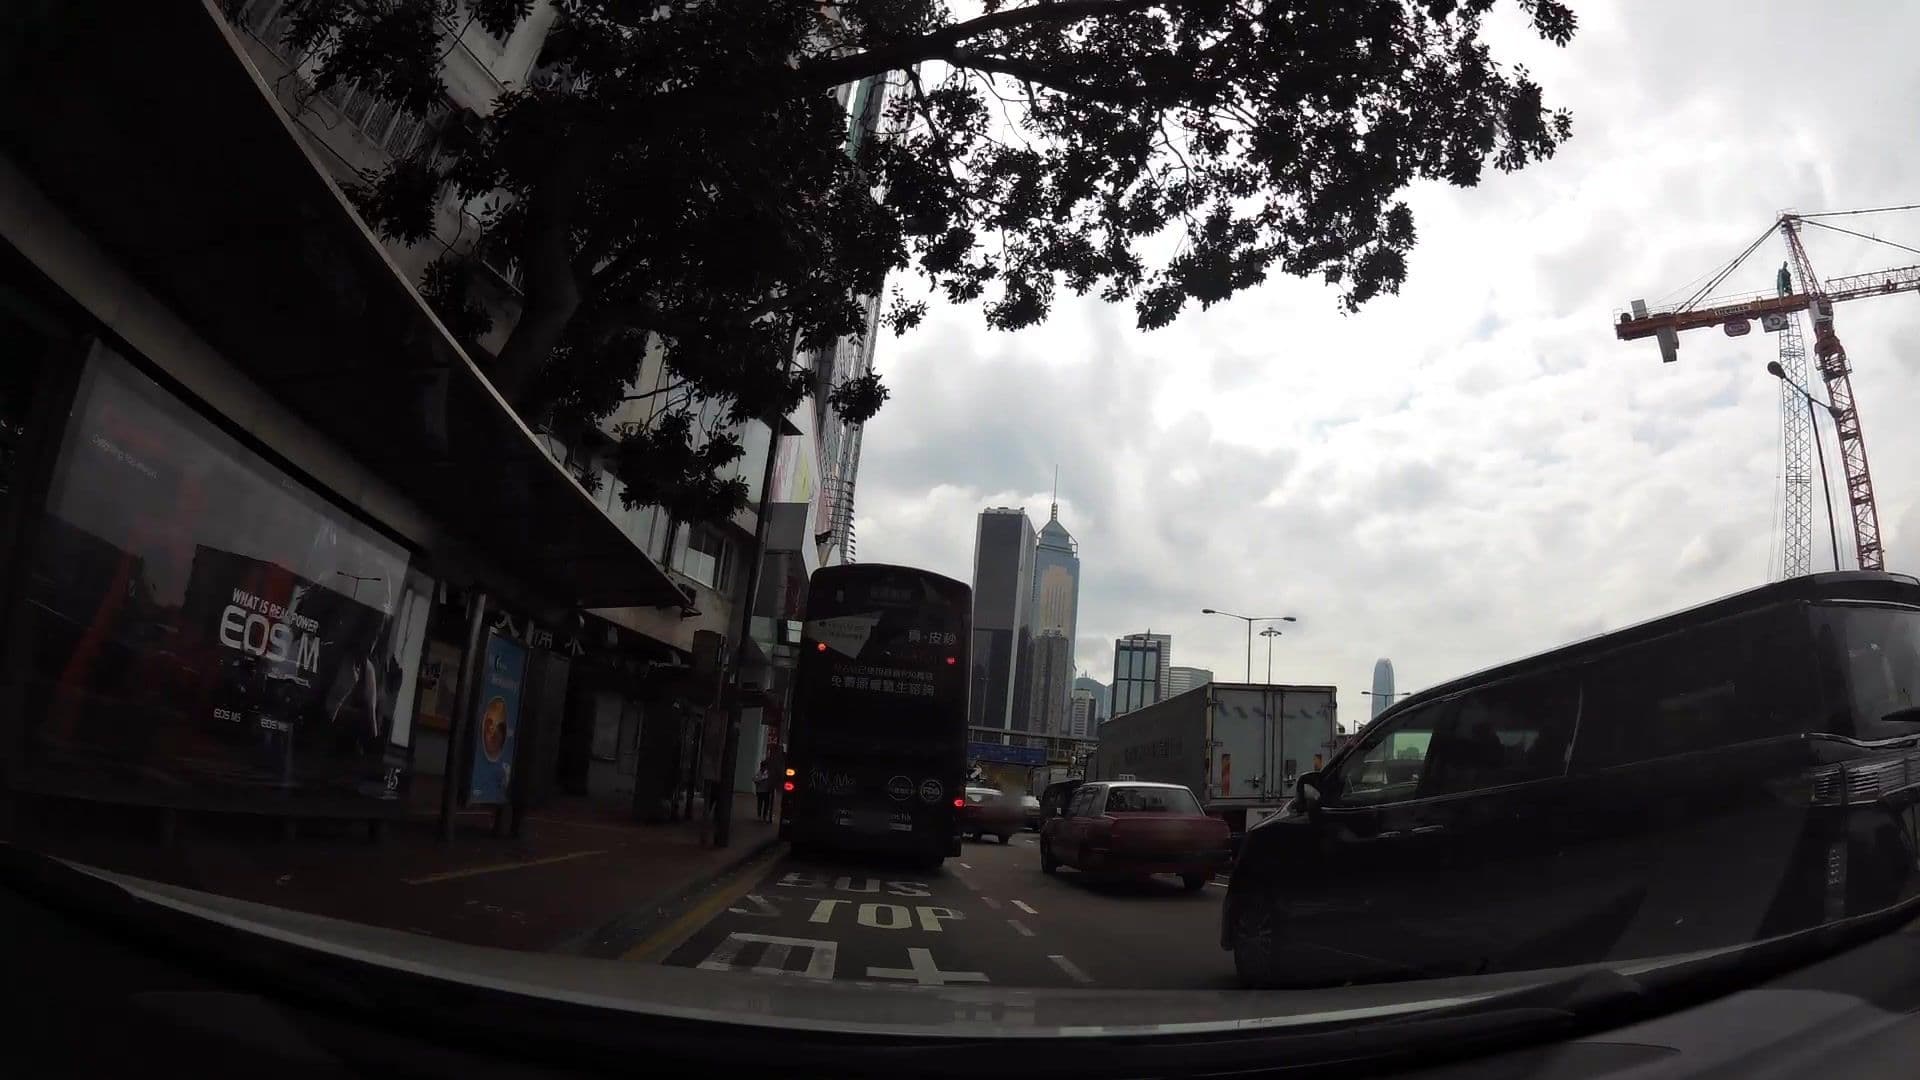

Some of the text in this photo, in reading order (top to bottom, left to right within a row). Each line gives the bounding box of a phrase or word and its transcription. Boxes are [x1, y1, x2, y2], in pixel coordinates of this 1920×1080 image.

[232, 588, 260, 611] WHAT
[259, 599, 270, 614] IS
[219, 603, 321, 674] EOS M
[776, 871, 932, 897] BUS
[728, 894, 967, 932] STOP
